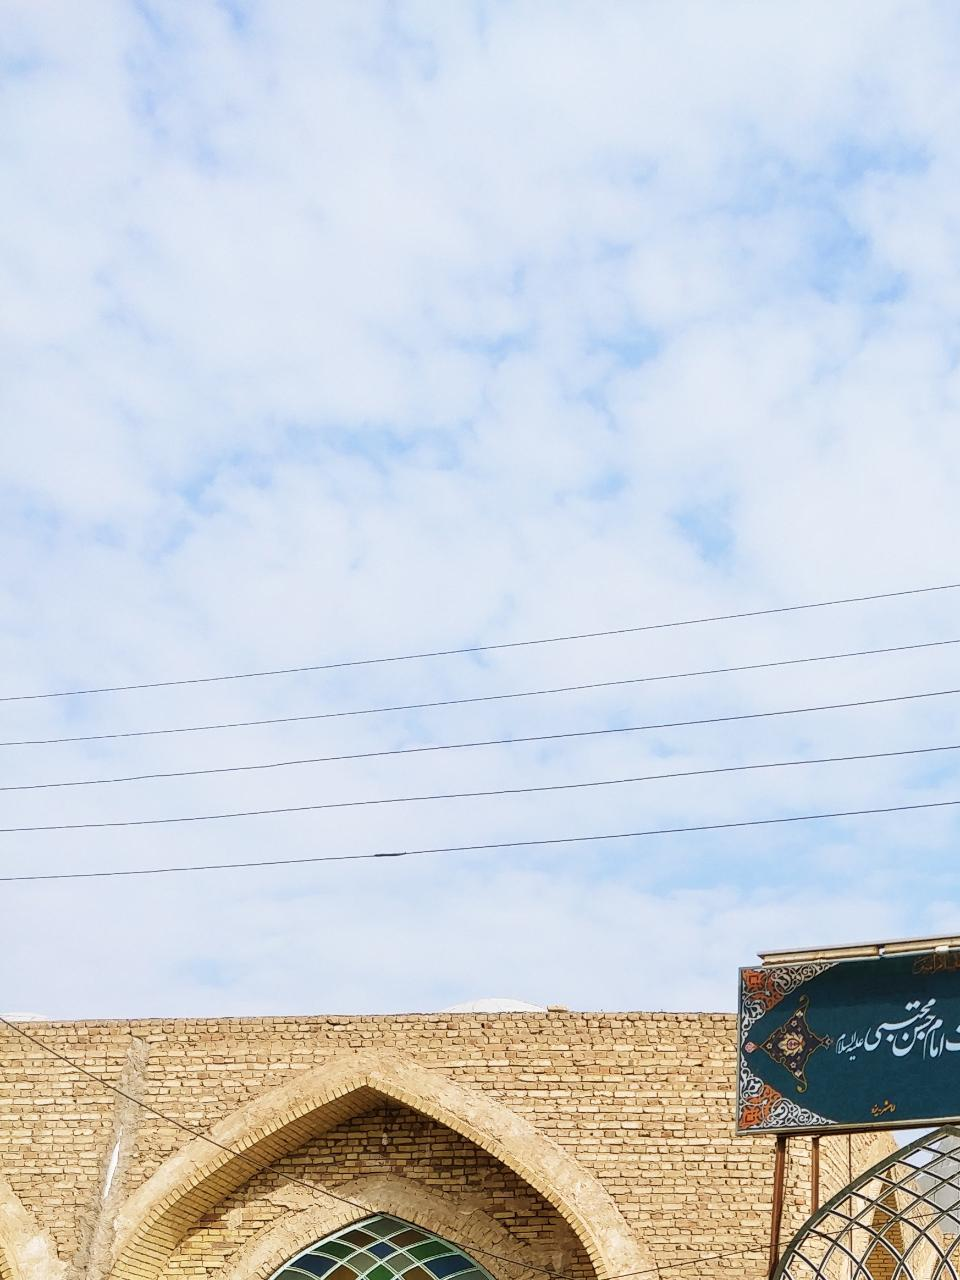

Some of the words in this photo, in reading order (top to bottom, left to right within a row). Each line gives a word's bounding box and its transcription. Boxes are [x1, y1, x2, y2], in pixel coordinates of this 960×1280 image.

[864, 998, 937, 1052] مجتبی
[892, 1014, 937, 1057] حسن
[923, 1019, 945, 1060] امام
